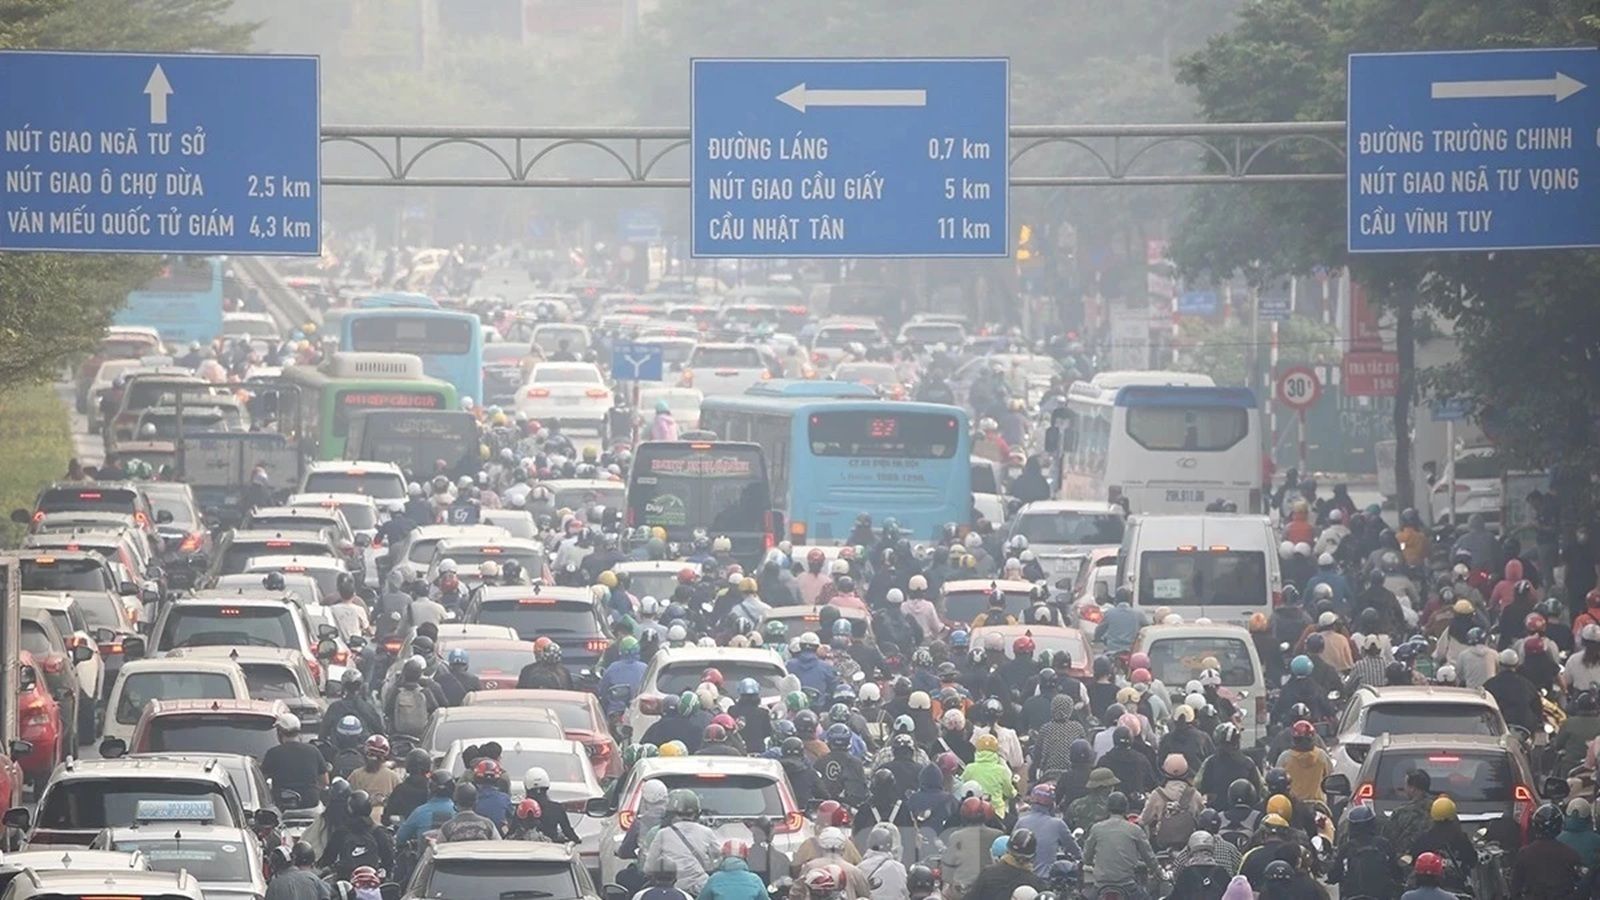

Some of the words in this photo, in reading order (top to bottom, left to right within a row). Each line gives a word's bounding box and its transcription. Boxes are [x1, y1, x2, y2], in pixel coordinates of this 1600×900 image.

[6, 123, 42, 152] NÚT
[49, 130, 92, 154] GIAO
[100, 127, 138, 155] NGÃ
[147, 132, 172, 155] TƯ
[180, 125, 207, 156] SỞ
[707, 130, 772, 161] ĐƯỜNG
[779, 130, 828, 160] LÁNG
[928, 137, 955, 161] 0,7
[962, 137, 990, 159] km
[1358, 124, 1424, 155] ĐƯỜNG
[1432, 122, 1508, 152] TRƯỜNG
[1516, 127, 1572, 150] CHINH
[6, 164, 42, 193] NÚT
[49, 171, 92, 194] GIAO
[100, 168, 112, 195] Ô
[120, 172, 158, 200] CHỢ
[166, 166, 204, 196] DỪA
[282, 175, 311, 198] km
[709, 171, 745, 201] NÚT
[751, 178, 793, 200] GIAO
[801, 170, 836, 200] CẦU
[844, 170, 885, 200] GIẤY
[945, 177, 955, 200] 5
[962, 177, 991, 200] km
[1359, 165, 1397, 195] NÚT
[1402, 171, 1445, 194] GIAO
[1451, 165, 1489, 193] NGÃ
[1496, 169, 1522, 191] TƯ
[1529, 167, 1579, 195] VỌNG
[7, 206, 44, 233] VĂN
[50, 204, 95, 235] MIẾU
[101, 205, 151, 236] QUỐC
[157, 206, 182, 236] TỬ
[188, 207, 235, 237] GIÁM
[249, 215, 277, 239] 4,3
[282, 215, 311, 238] km
[709, 210, 745, 240] CẦU
[752, 214, 800, 243] NHẬT
[808, 214, 844, 240] TÂN
[937, 217, 955, 239] 11
[962, 217, 991, 239] km
[1360, 205, 1396, 236] CẦU
[1404, 207, 1448, 234] VĨNH
[1457, 210, 1492, 233] TUY
